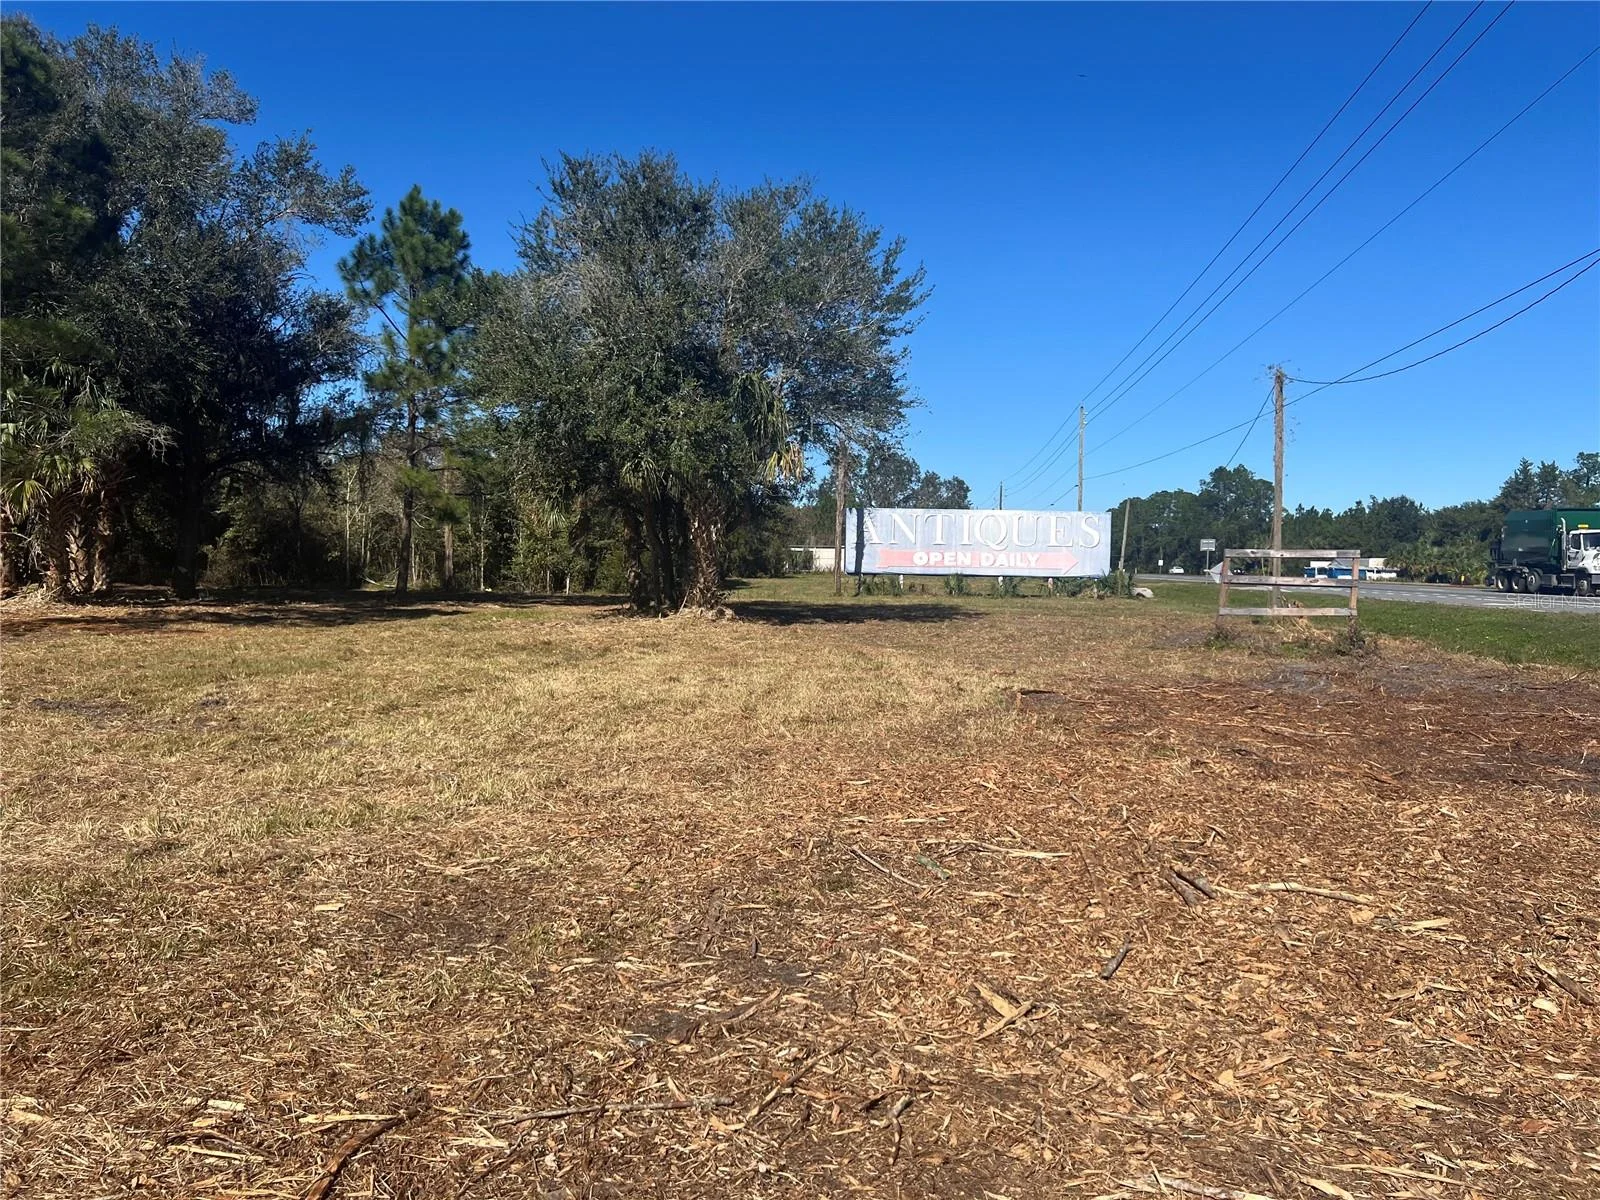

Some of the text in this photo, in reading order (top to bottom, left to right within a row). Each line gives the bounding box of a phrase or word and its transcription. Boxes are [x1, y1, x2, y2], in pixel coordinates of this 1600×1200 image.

[853, 511, 1100, 550] ANTIQUES
[912, 552, 1040, 568] OPEN DAILY
